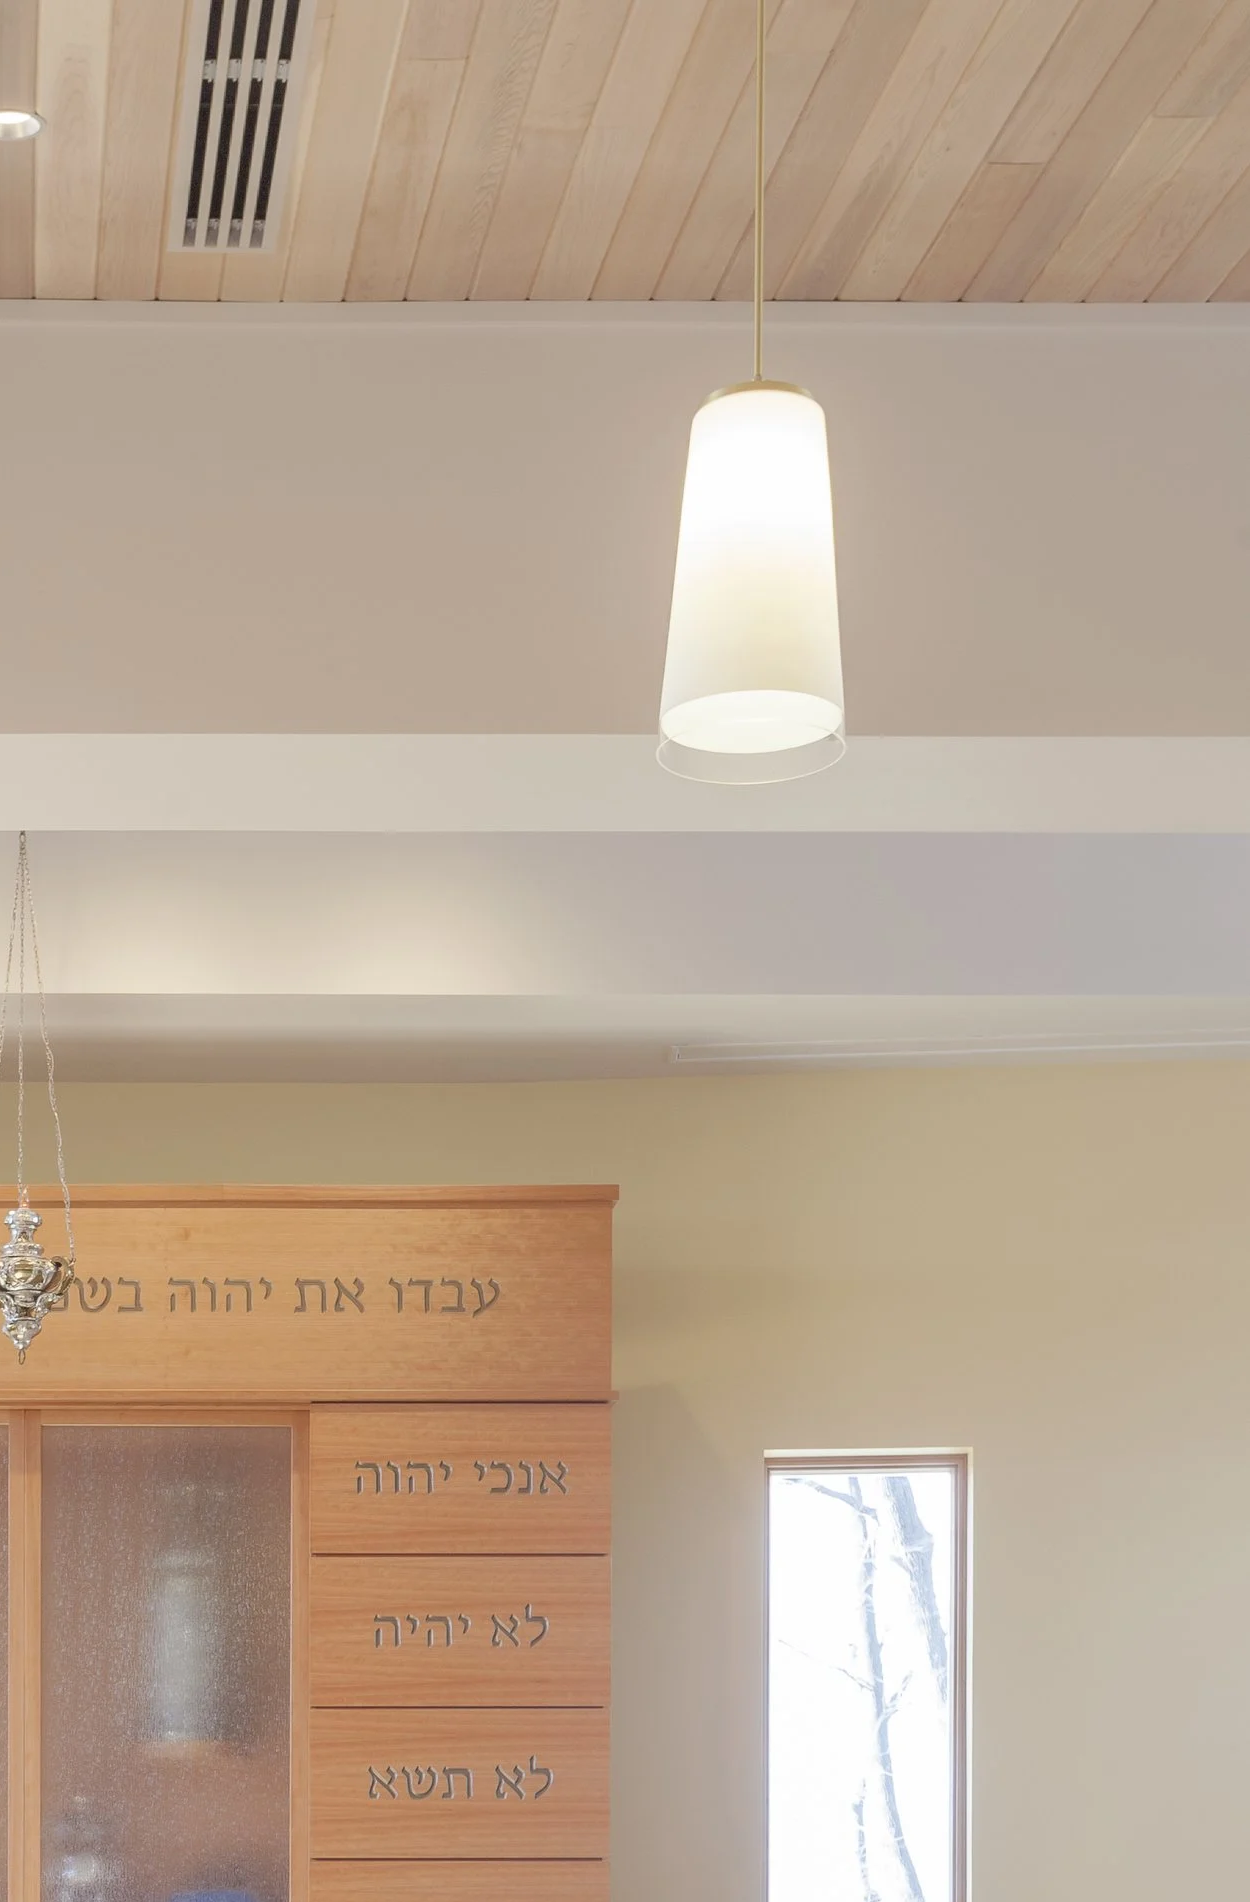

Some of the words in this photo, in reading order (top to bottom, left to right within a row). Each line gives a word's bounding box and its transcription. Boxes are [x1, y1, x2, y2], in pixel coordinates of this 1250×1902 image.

[167, 1276, 274, 1313] יהוה
[294, 1277, 365, 1314] את
[388, 1277, 502, 1317] עבדו
[354, 1460, 454, 1497] יהוה
[473, 1460, 570, 1497] אנכי
[372, 1614, 473, 1650] יהיה
[489, 1604, 551, 1650] לא
[366, 1764, 475, 1802] תשא
[494, 1755, 555, 1801] לא
